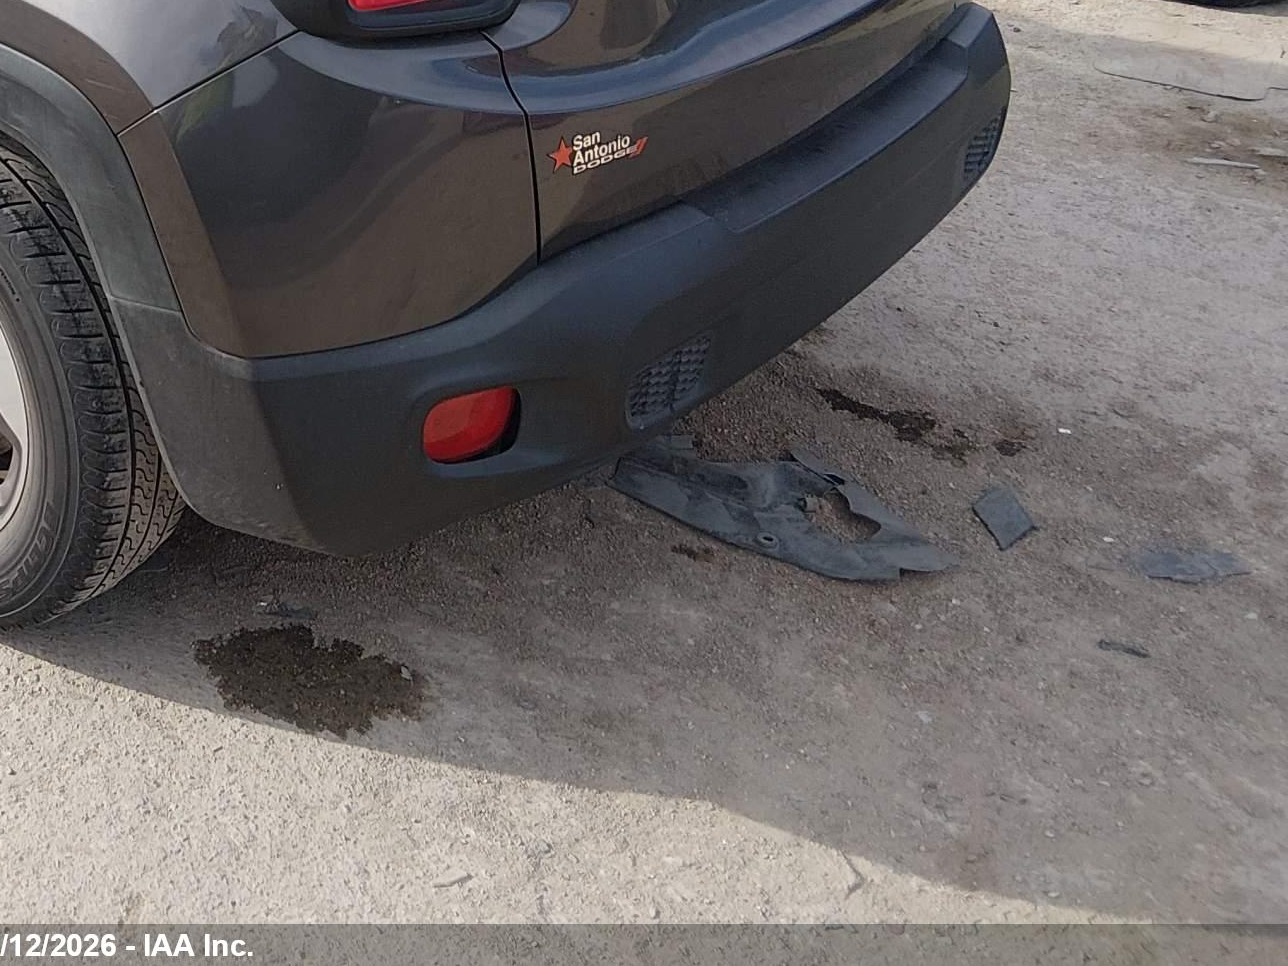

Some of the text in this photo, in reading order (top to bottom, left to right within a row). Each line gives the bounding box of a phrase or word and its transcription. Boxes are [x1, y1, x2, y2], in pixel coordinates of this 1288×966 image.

[572, 130, 601, 151] San
[572, 135, 631, 167] Antonio
[572, 144, 638, 175] DODGE
